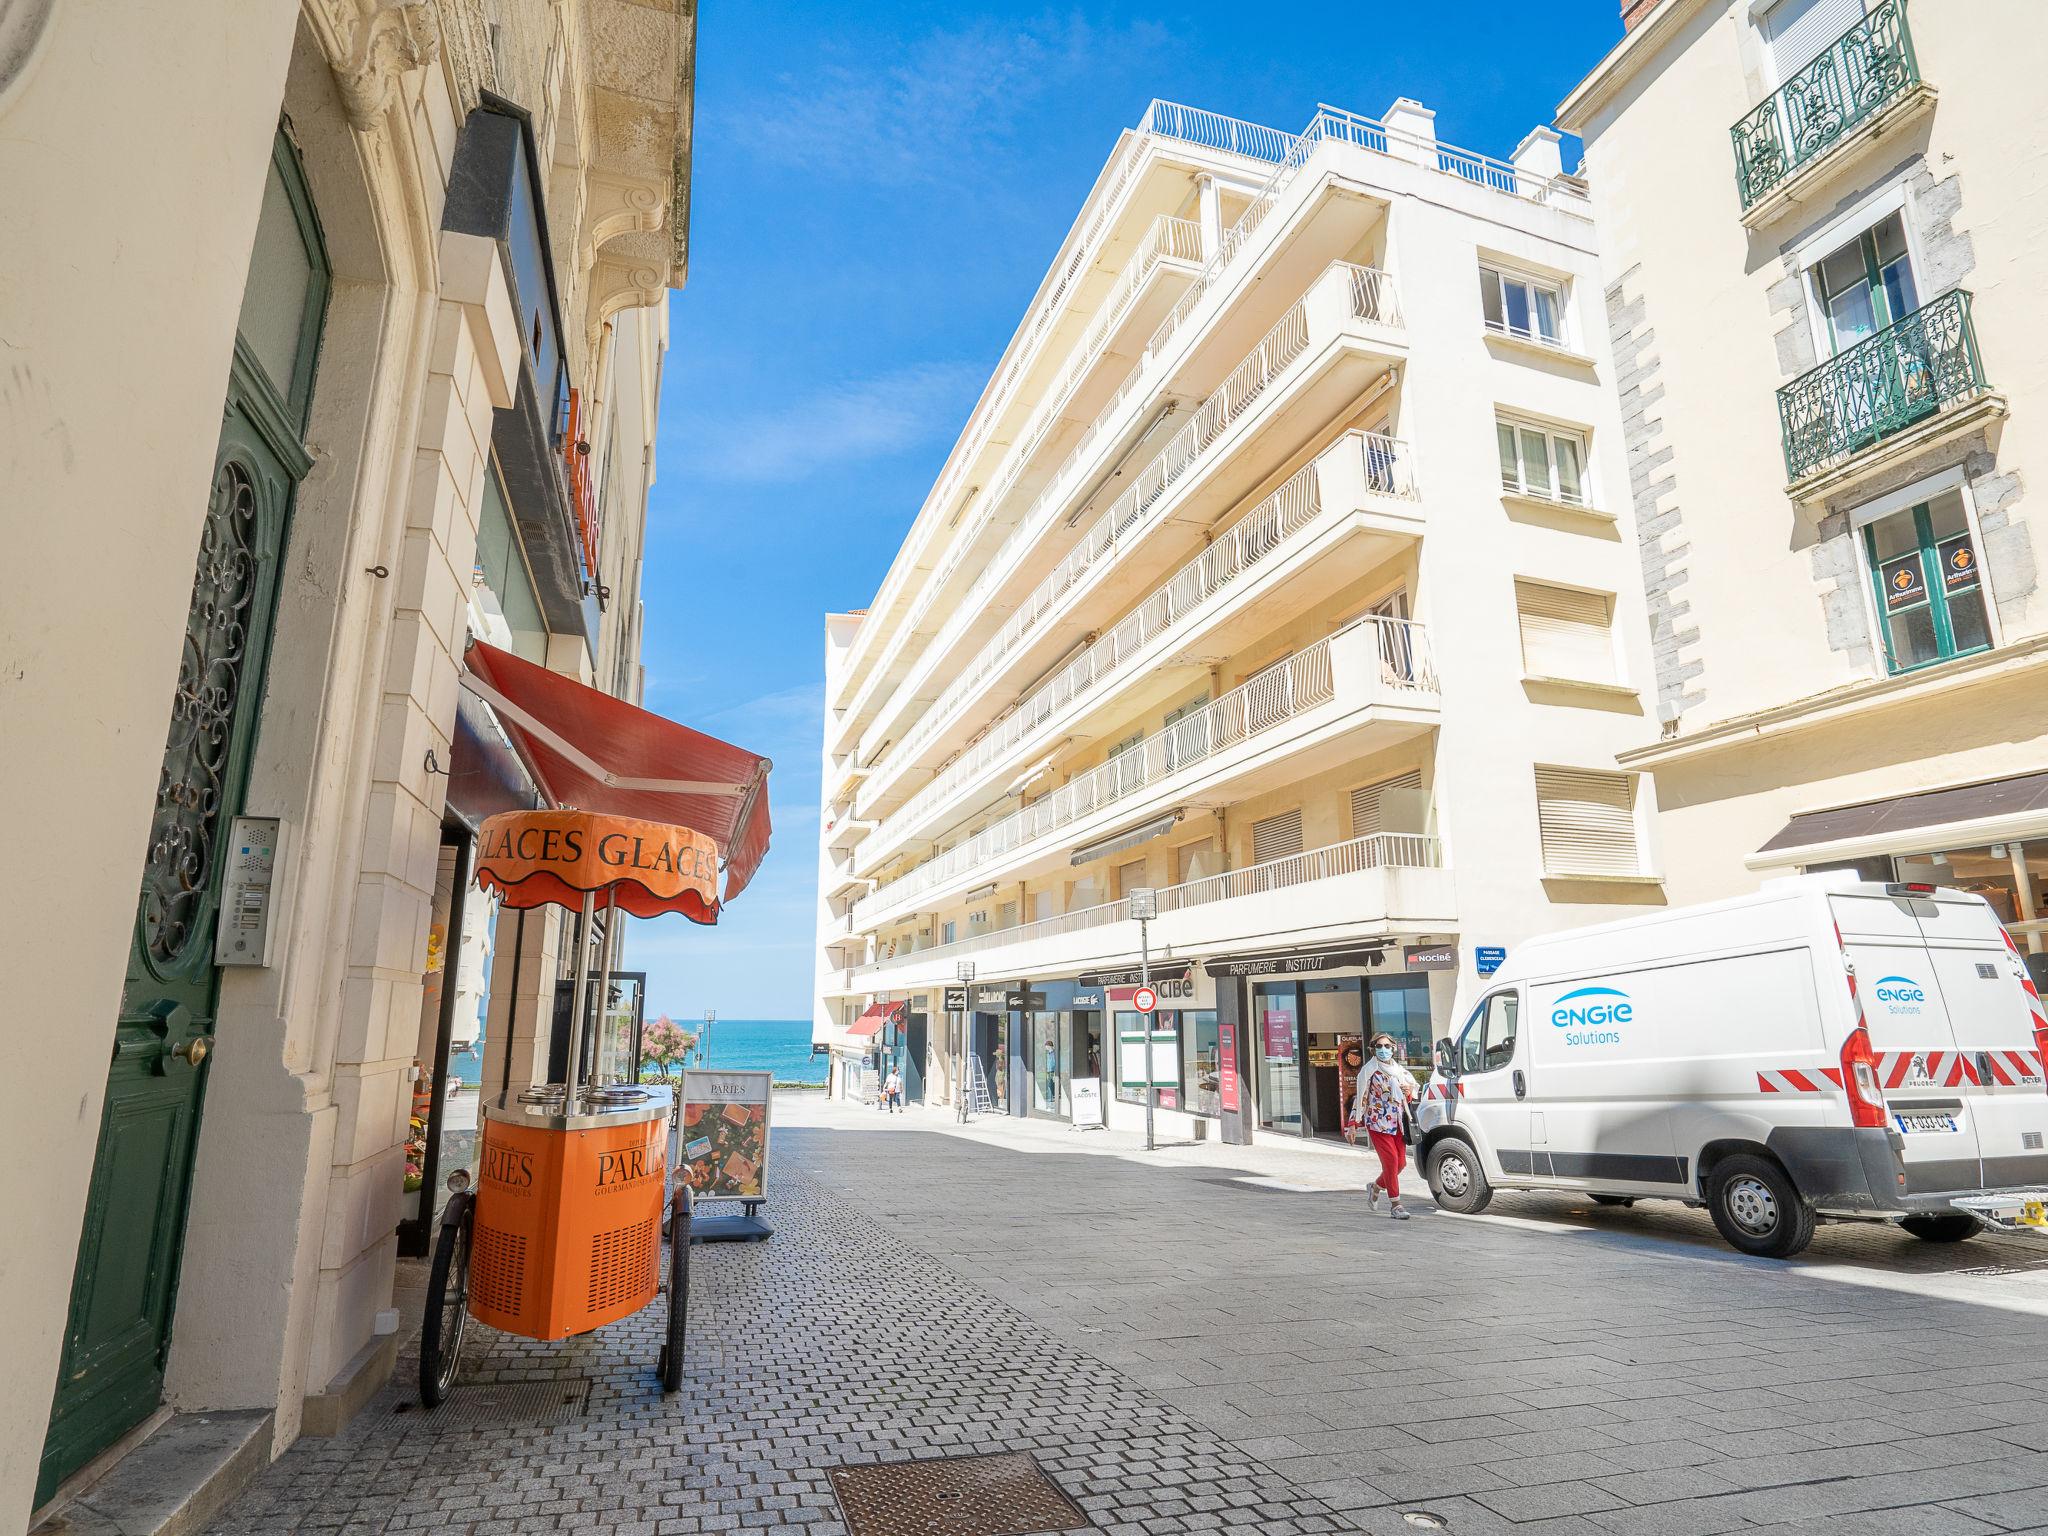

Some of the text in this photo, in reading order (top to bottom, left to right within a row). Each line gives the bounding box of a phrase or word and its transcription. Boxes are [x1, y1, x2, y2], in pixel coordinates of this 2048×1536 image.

[477, 828, 713, 881] GLACES GLACES
[1229, 957, 1325, 975] PARFUMERIE INSTITUT
[1097, 971, 1152, 986] PARFUMERIE INSTIT
[1888, 1005, 1921, 1015] Solutions
[1565, 1030, 1620, 1046] Solutions
[1902, 1115, 1950, 1130] FX-033-CC
[479, 1146, 533, 1188] ARIÈS
